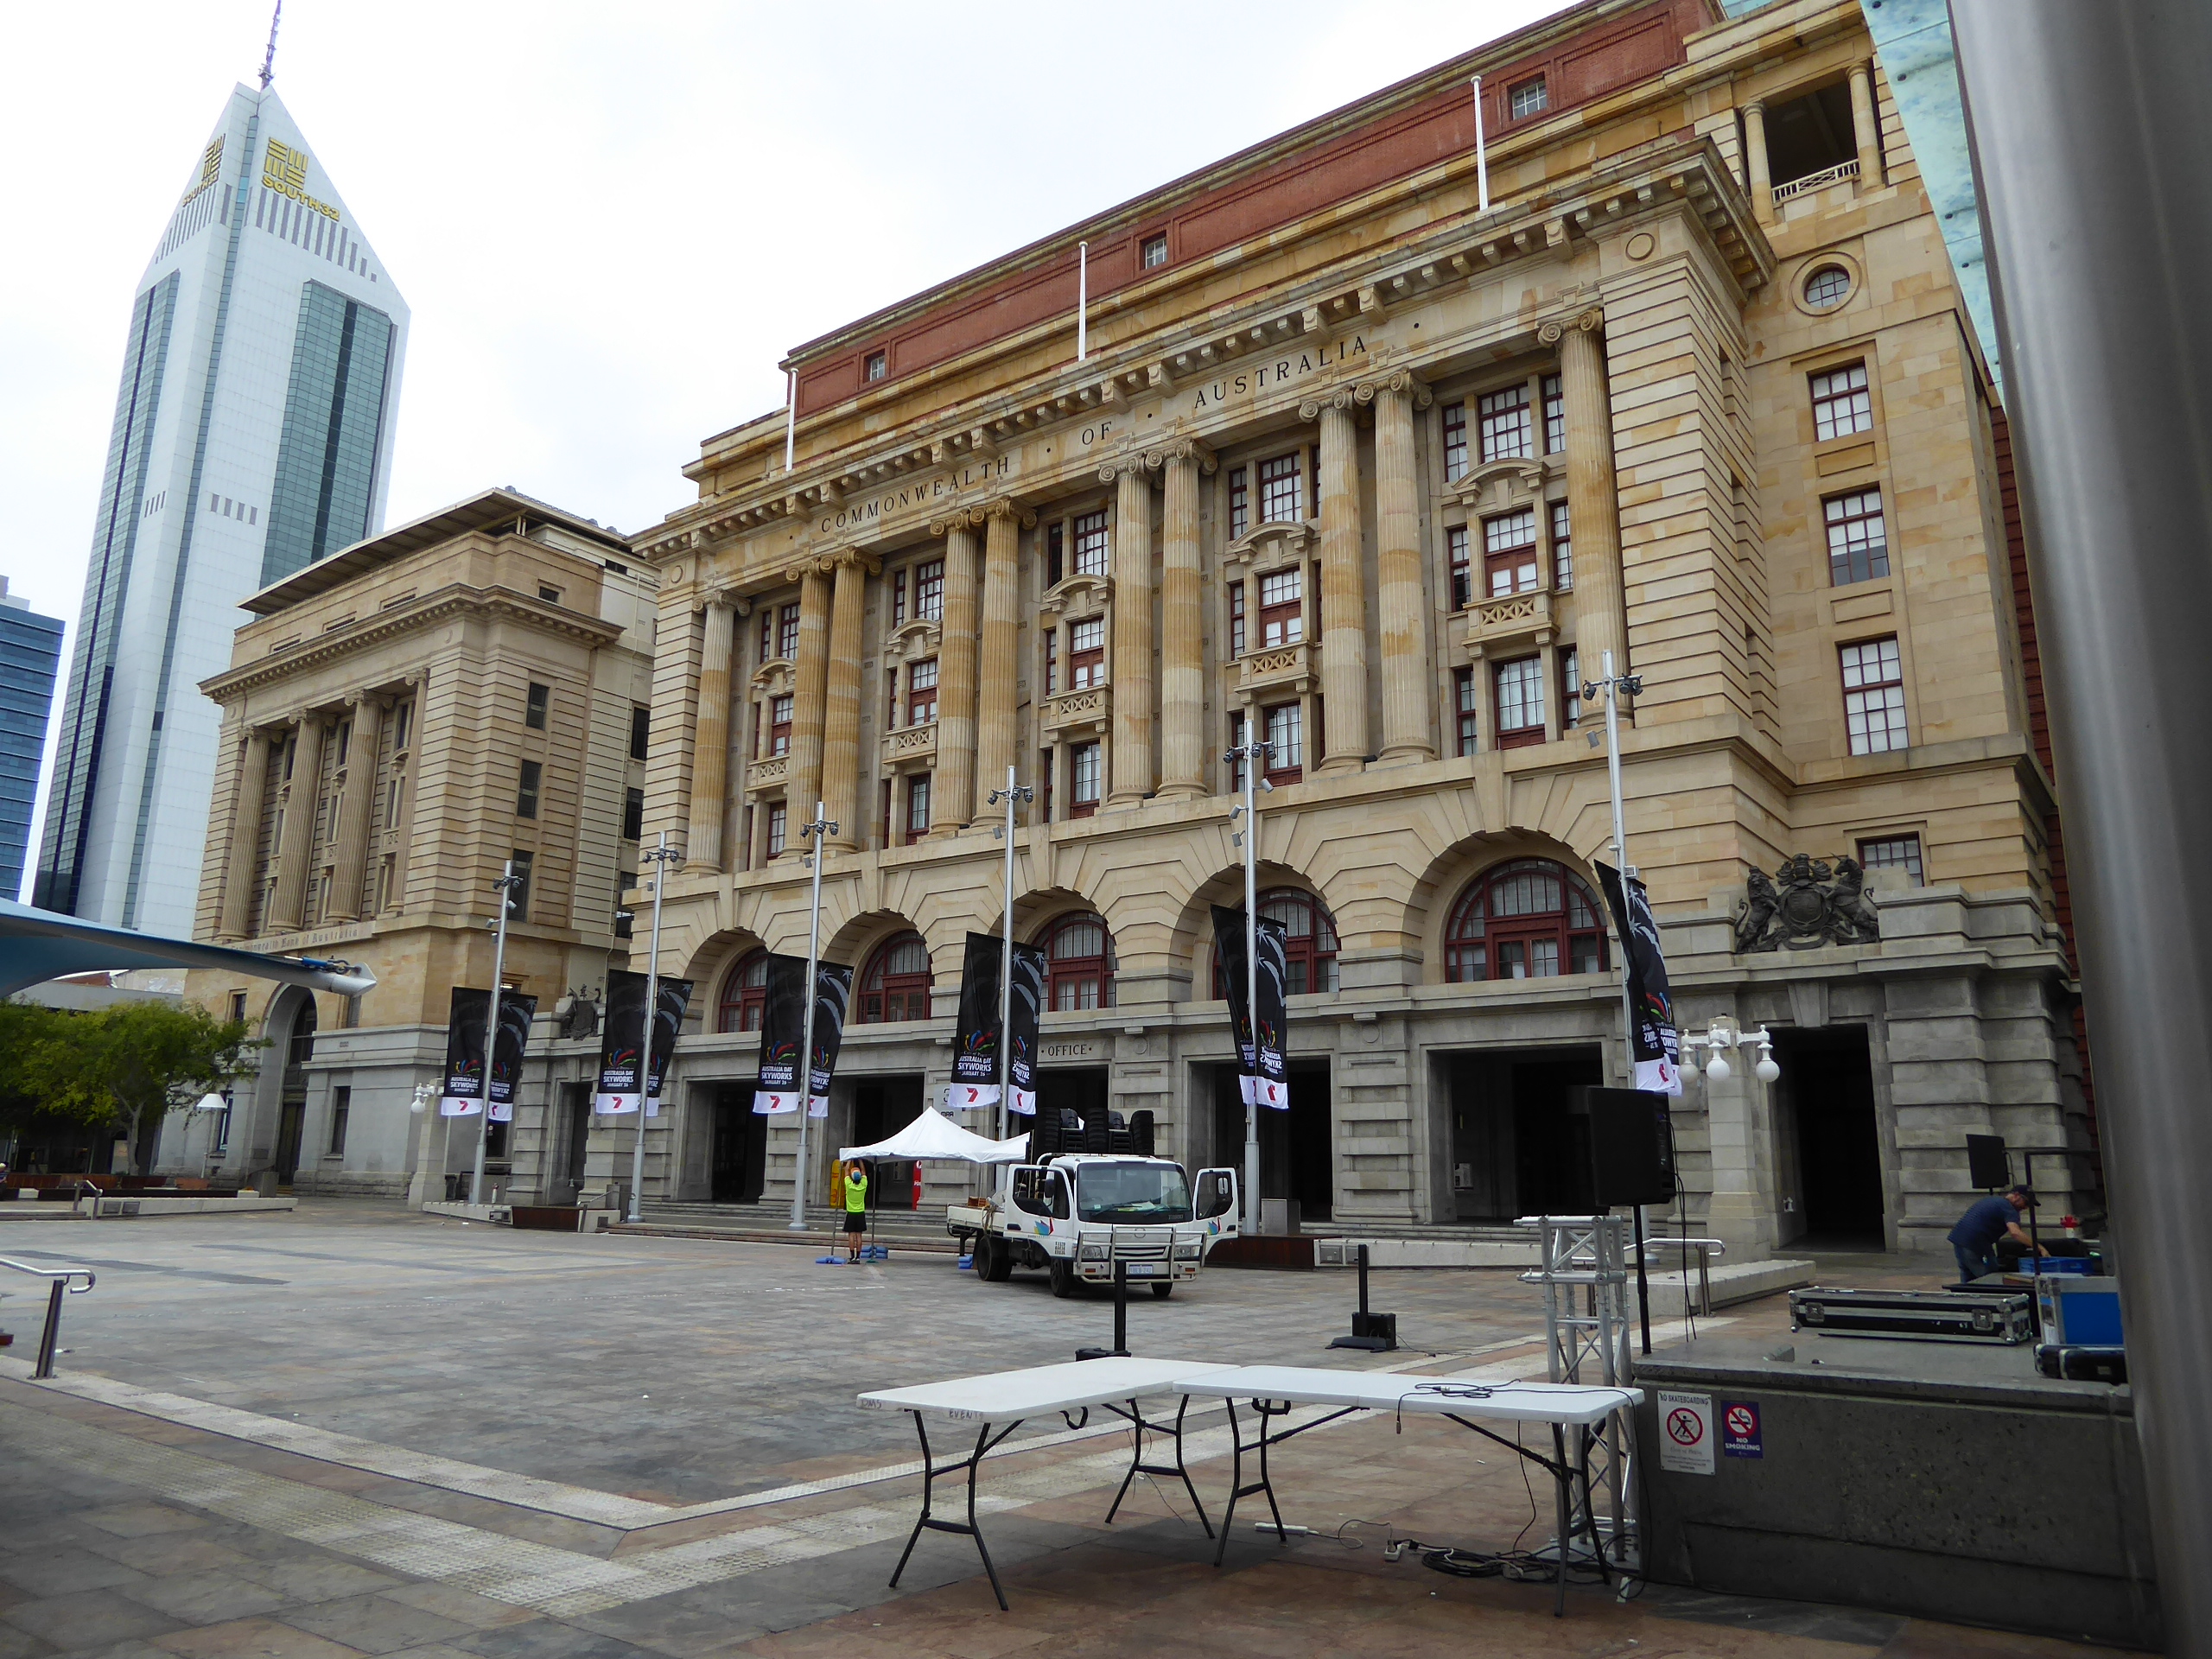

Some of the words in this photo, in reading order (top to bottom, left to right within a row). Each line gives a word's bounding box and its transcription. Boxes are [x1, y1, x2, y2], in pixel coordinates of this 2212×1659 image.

[262, 174, 340, 222] SOUTH32
[822, 456, 1009, 533] COMMONWEALTH
[1082, 421, 1112, 445] OF
[1194, 335, 1367, 409] AUSTRALIA
[1048, 1044, 1087, 1056] OFFICE
[957, 1063, 992, 1071] SKYWORKS
[966, 1087, 979, 1103] 7
[459, 1100, 469, 1111] 7
[612, 1096, 623, 1109] 7
[770, 1095, 781, 1109] 7
[1669, 1395, 1708, 1405] SKATEBOARDING
[1725, 1442, 1761, 1452] SMOKING
